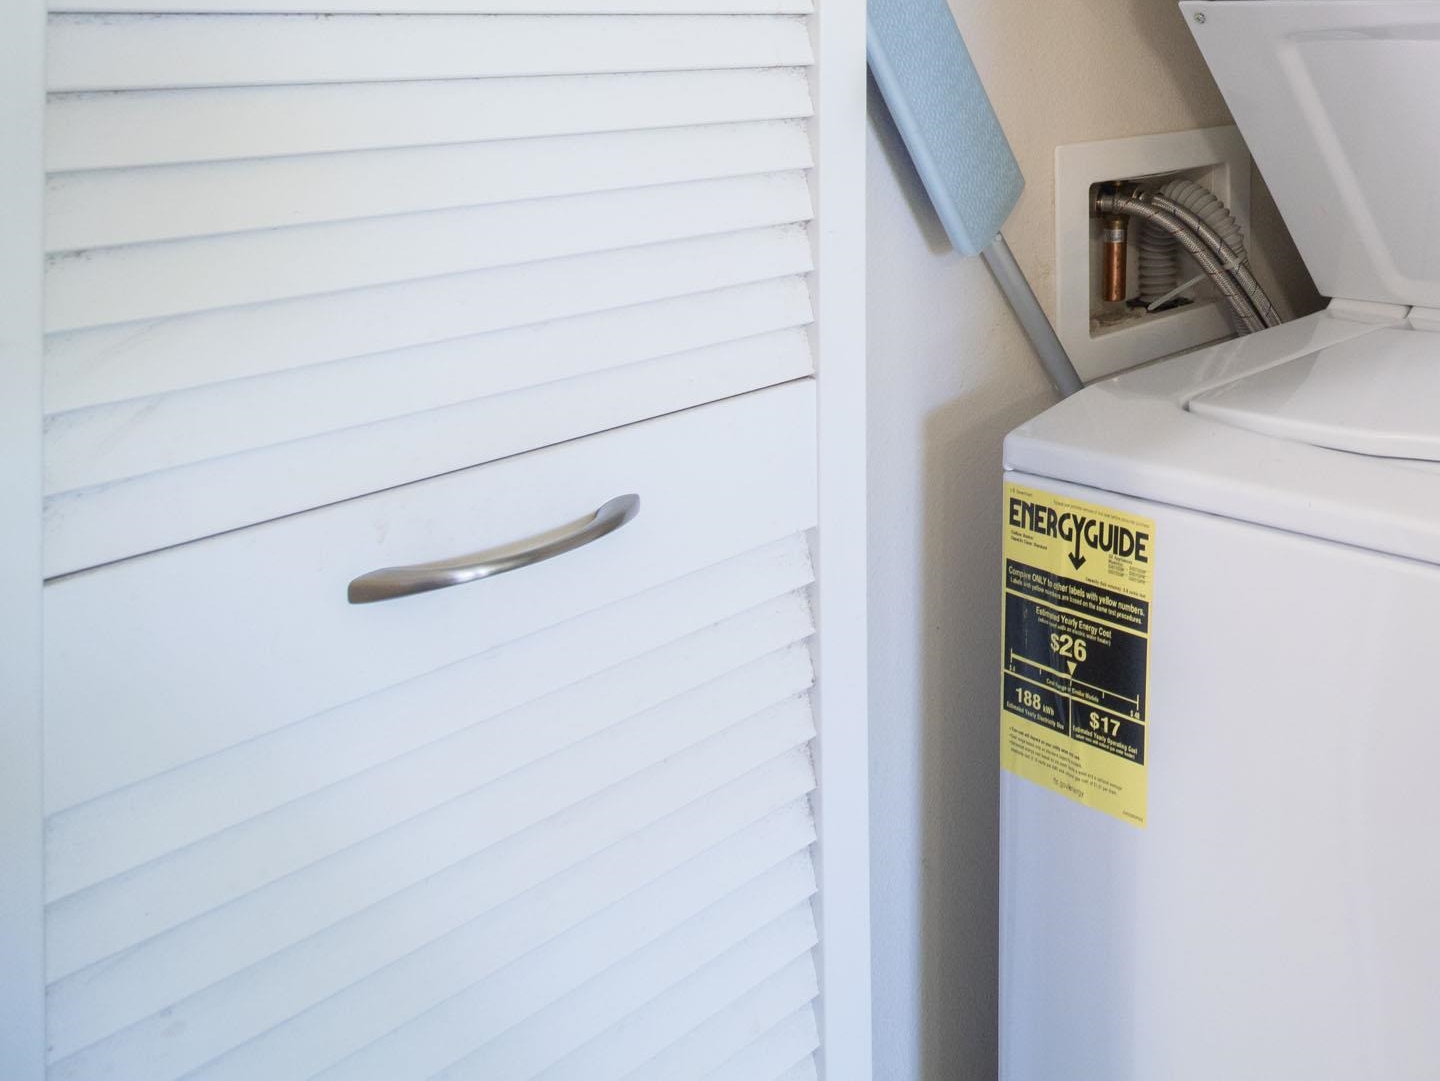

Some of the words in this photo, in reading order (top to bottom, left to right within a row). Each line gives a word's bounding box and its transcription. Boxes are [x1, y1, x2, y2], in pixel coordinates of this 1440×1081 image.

[1009, 497, 1149, 565] ENERGYGUIDE
[1008, 566, 1031, 579] Compare
[1032, 573, 1047, 586] ONLY
[1053, 582, 1068, 592] other
[1068, 585, 1085, 598] labels
[1086, 591, 1098, 601] with
[1099, 596, 1117, 607] yellow
[1036, 606, 1060, 622] Estimated
[1060, 615, 1078, 629] Yearly
[1078, 620, 1097, 635] Energy
[1099, 627, 1112, 639] Cost
[1050, 633, 1087, 662] $26
[1015, 687, 1041, 710] 188
[1090, 712, 1120, 737] $17
